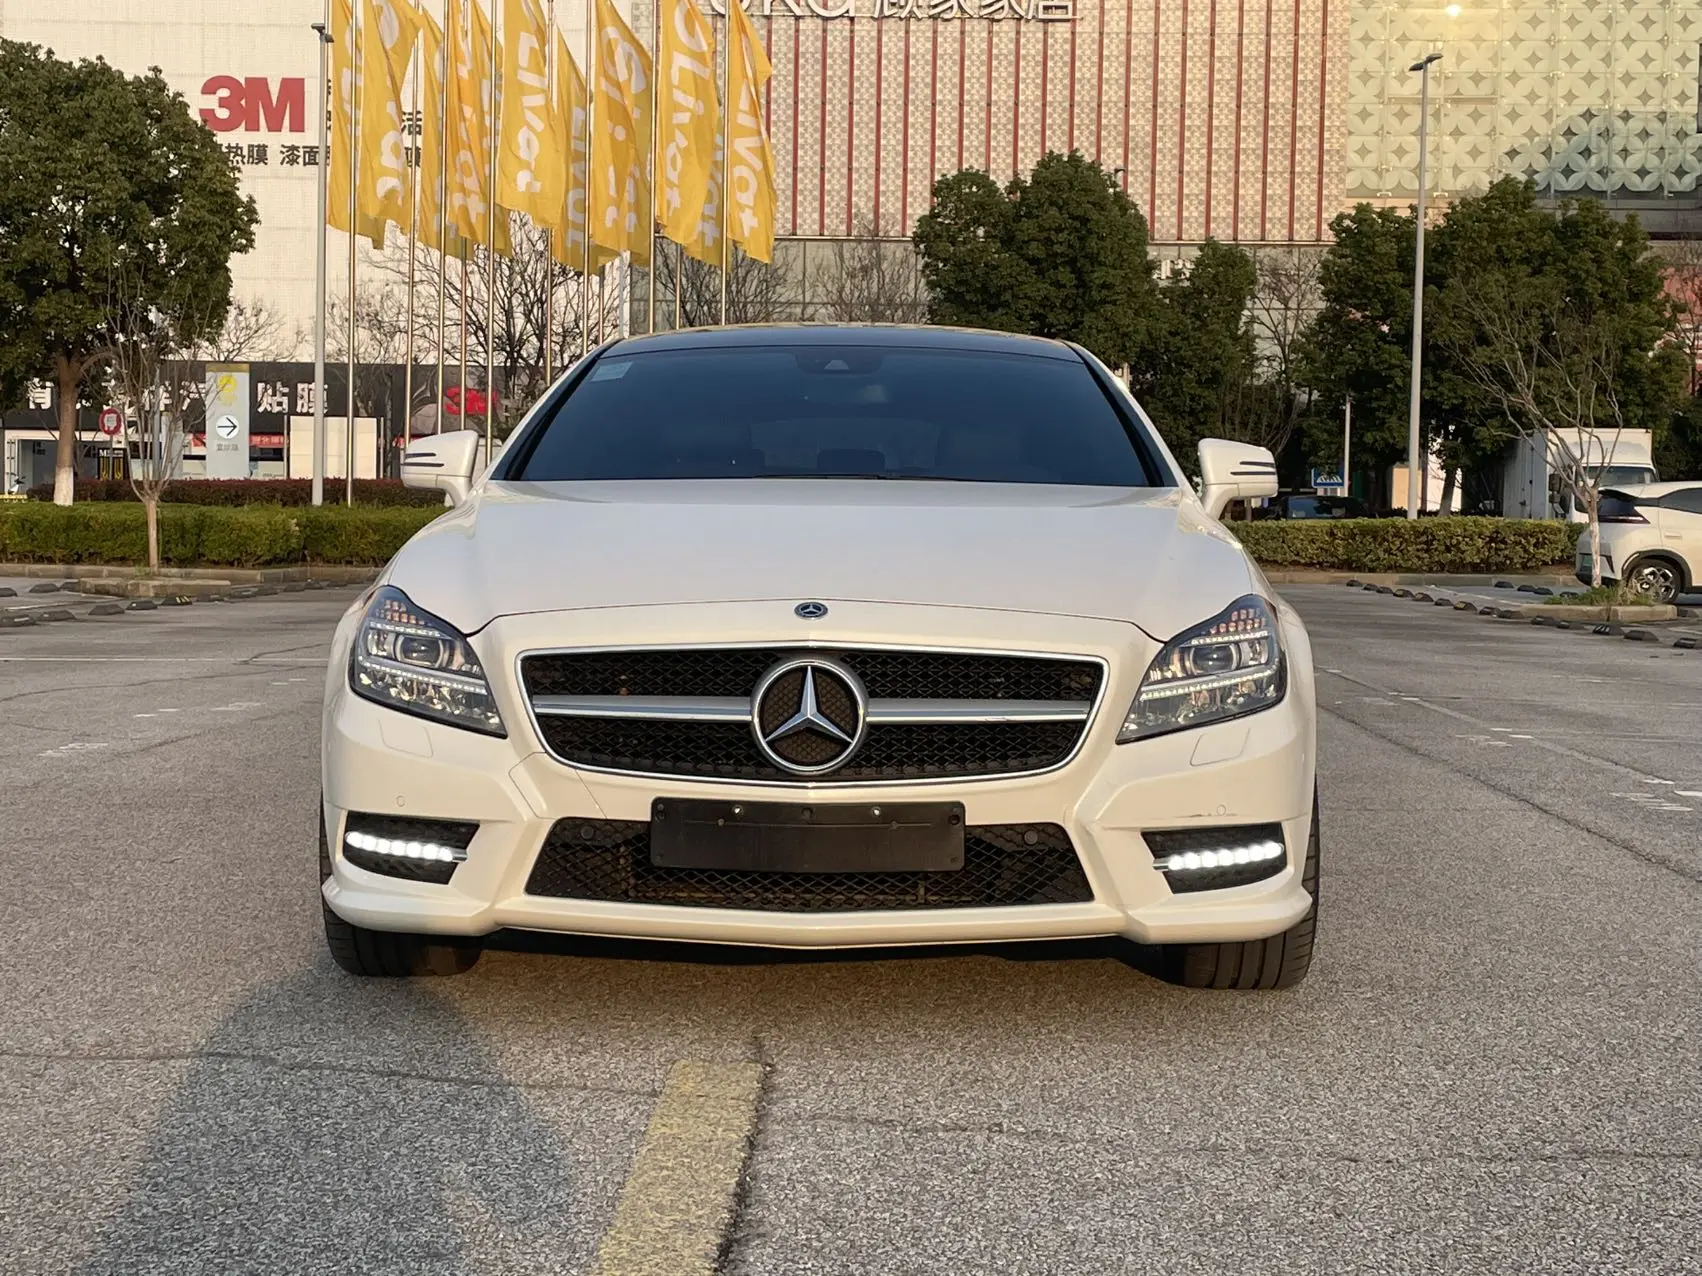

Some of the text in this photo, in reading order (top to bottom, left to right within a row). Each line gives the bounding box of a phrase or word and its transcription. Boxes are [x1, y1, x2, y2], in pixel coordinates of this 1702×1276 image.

[199, 75, 305, 133] 3M
[217, 143, 331, 167] 热膜 漆面
